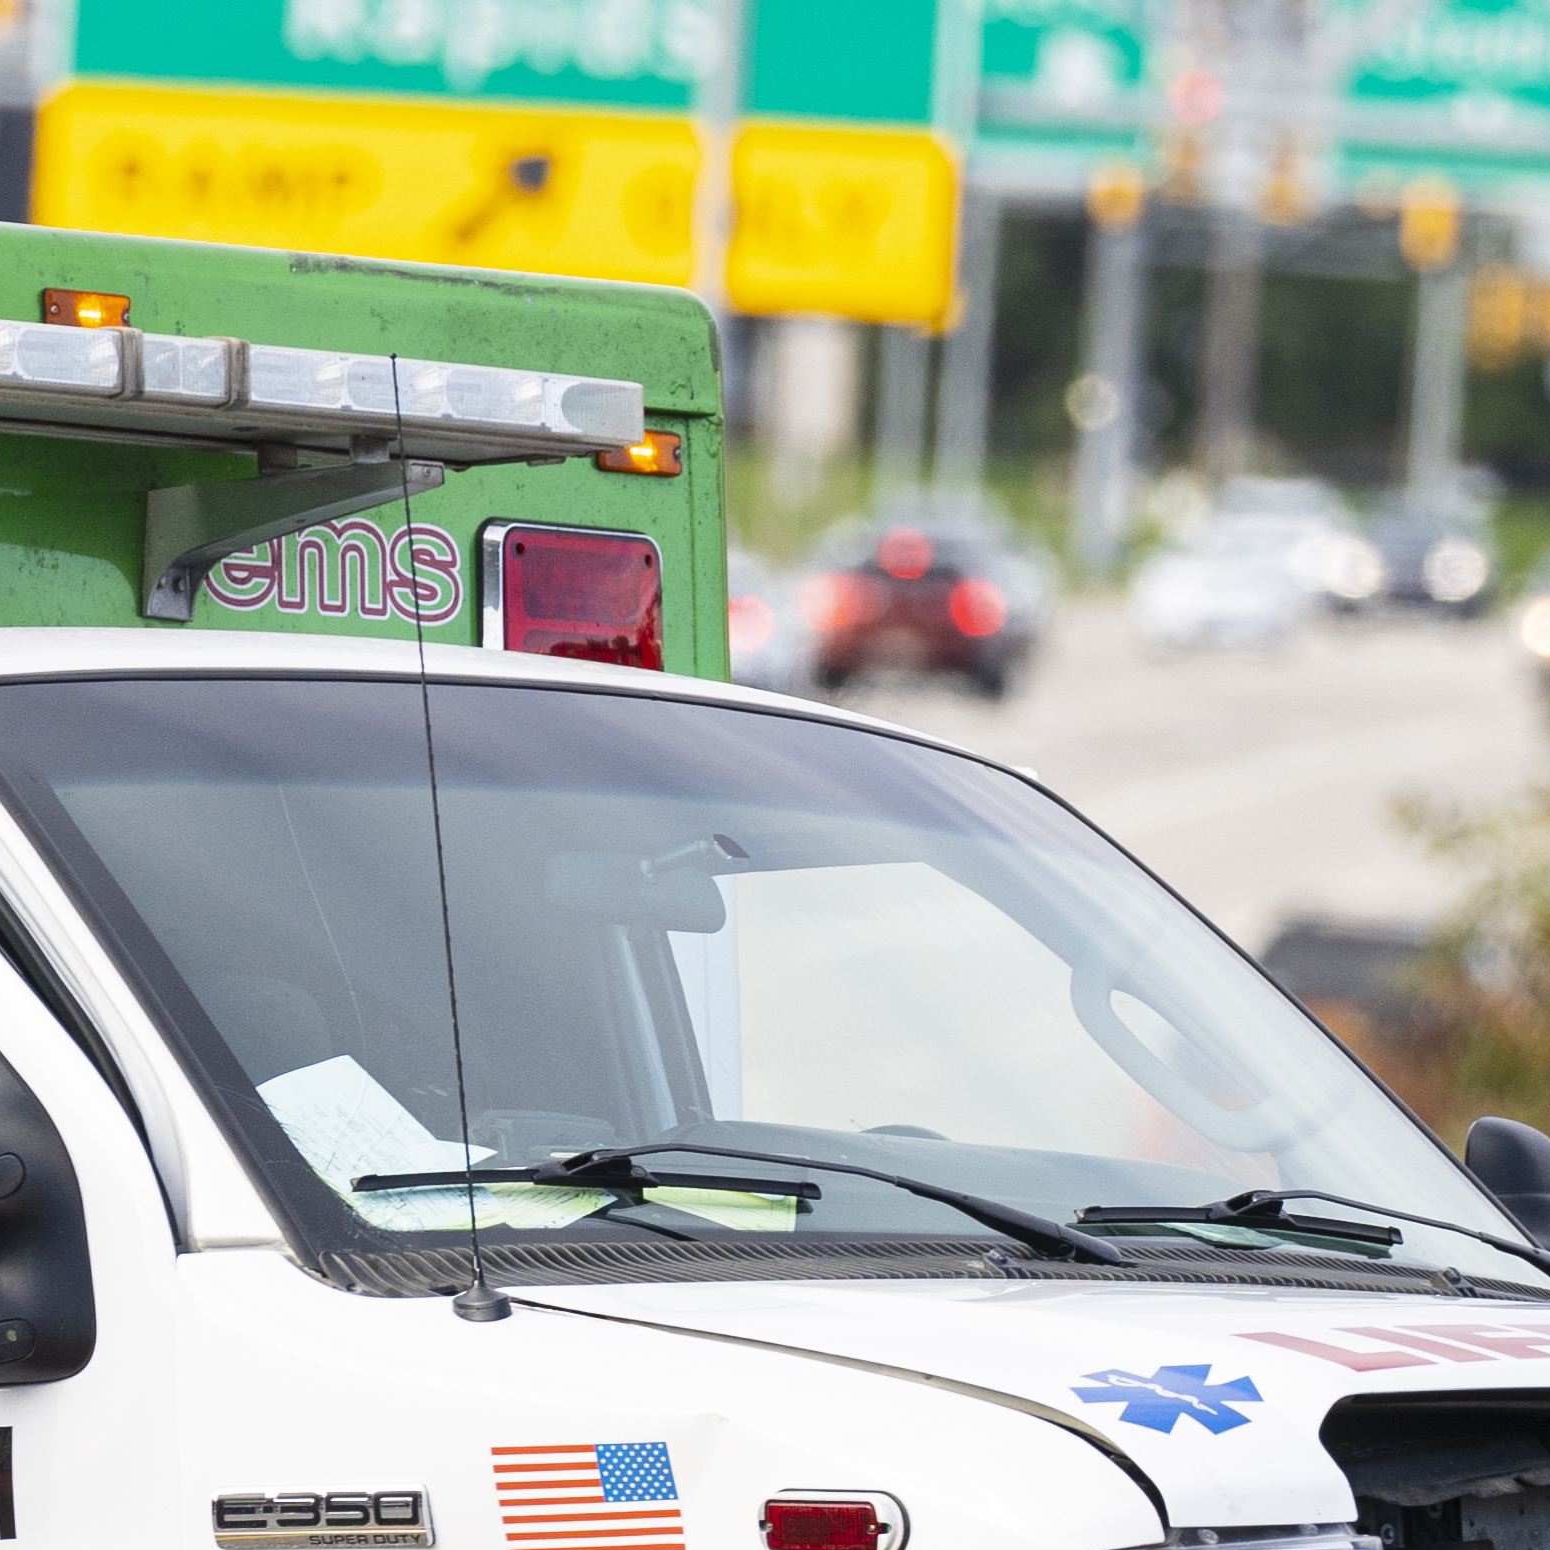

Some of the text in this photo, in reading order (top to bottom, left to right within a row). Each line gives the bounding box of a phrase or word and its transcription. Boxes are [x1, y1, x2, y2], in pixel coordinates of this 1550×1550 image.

[203, 517, 464, 626] ems
[309, 1534, 422, 1545] SUPER DUTY
